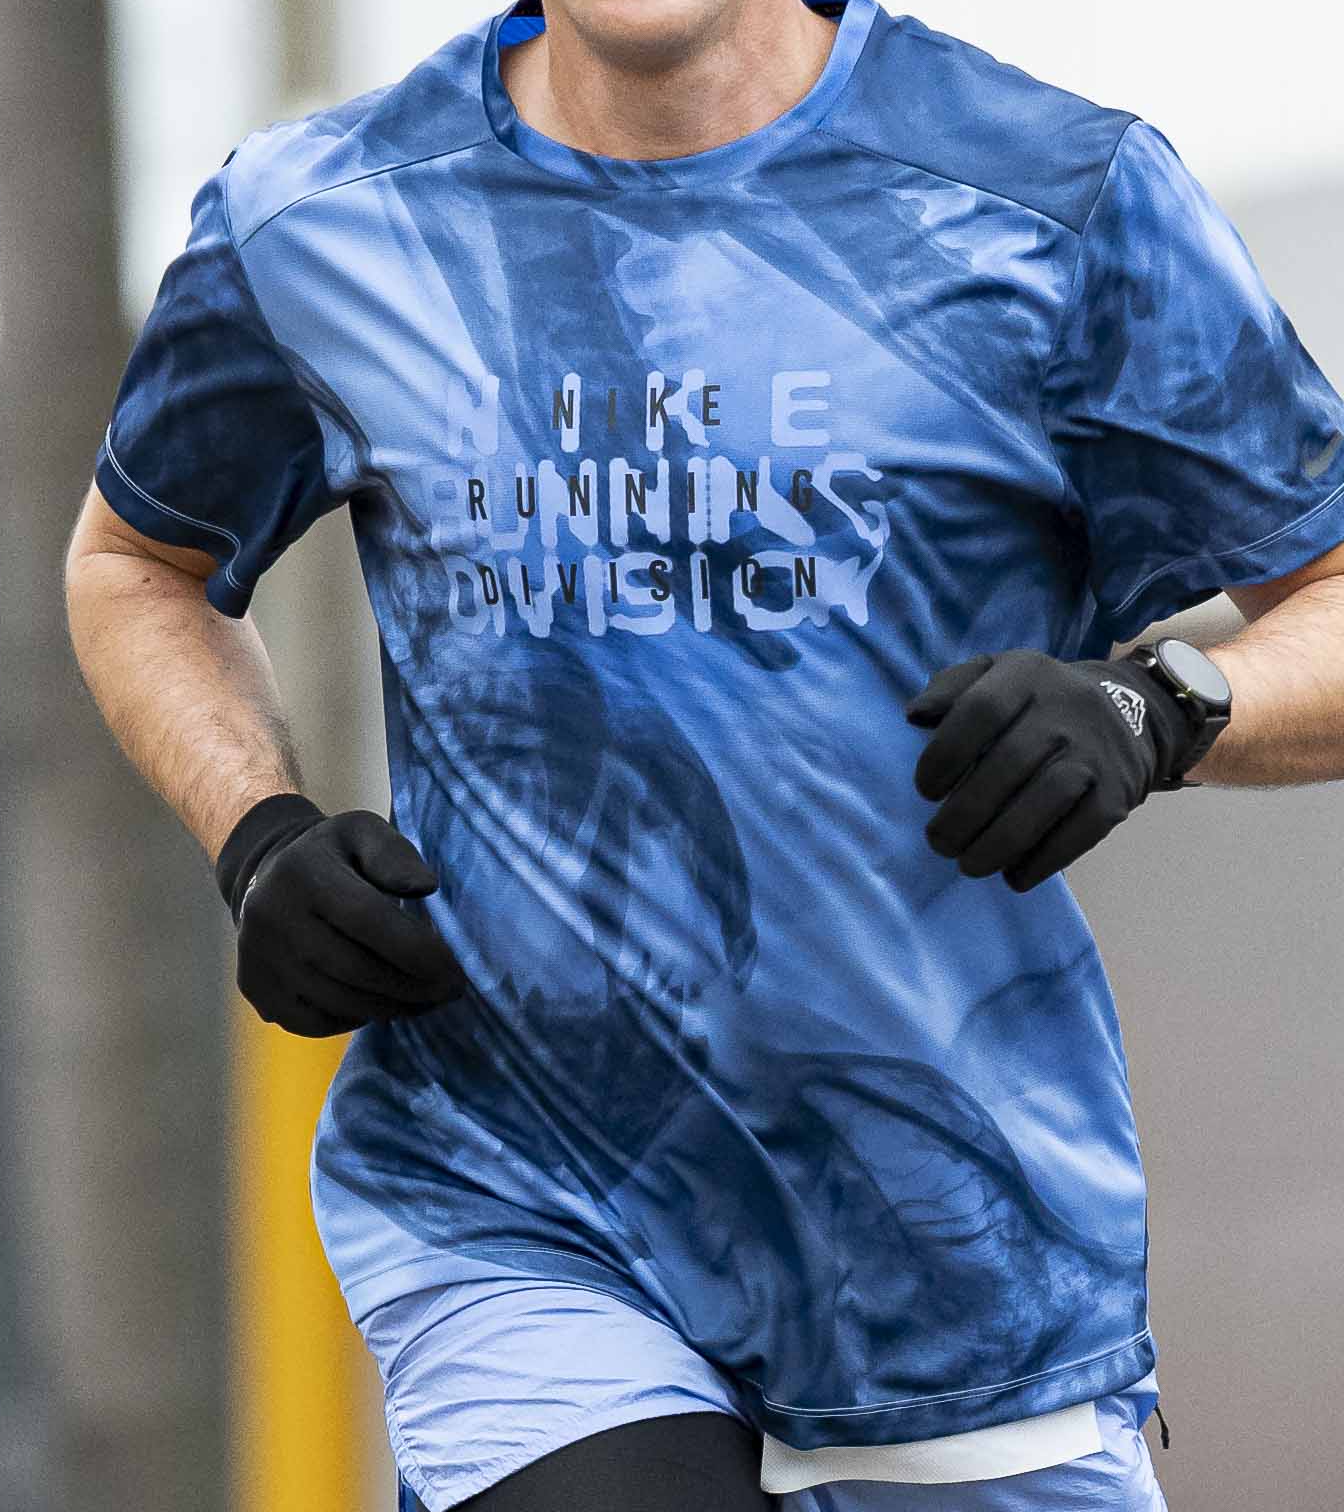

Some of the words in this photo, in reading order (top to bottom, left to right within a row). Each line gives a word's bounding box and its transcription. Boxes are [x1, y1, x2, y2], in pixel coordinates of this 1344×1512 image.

[552, 384, 722, 432] NIKE
[467, 468, 814, 522] RUNNING
[478, 555, 818, 606] DIVISION
